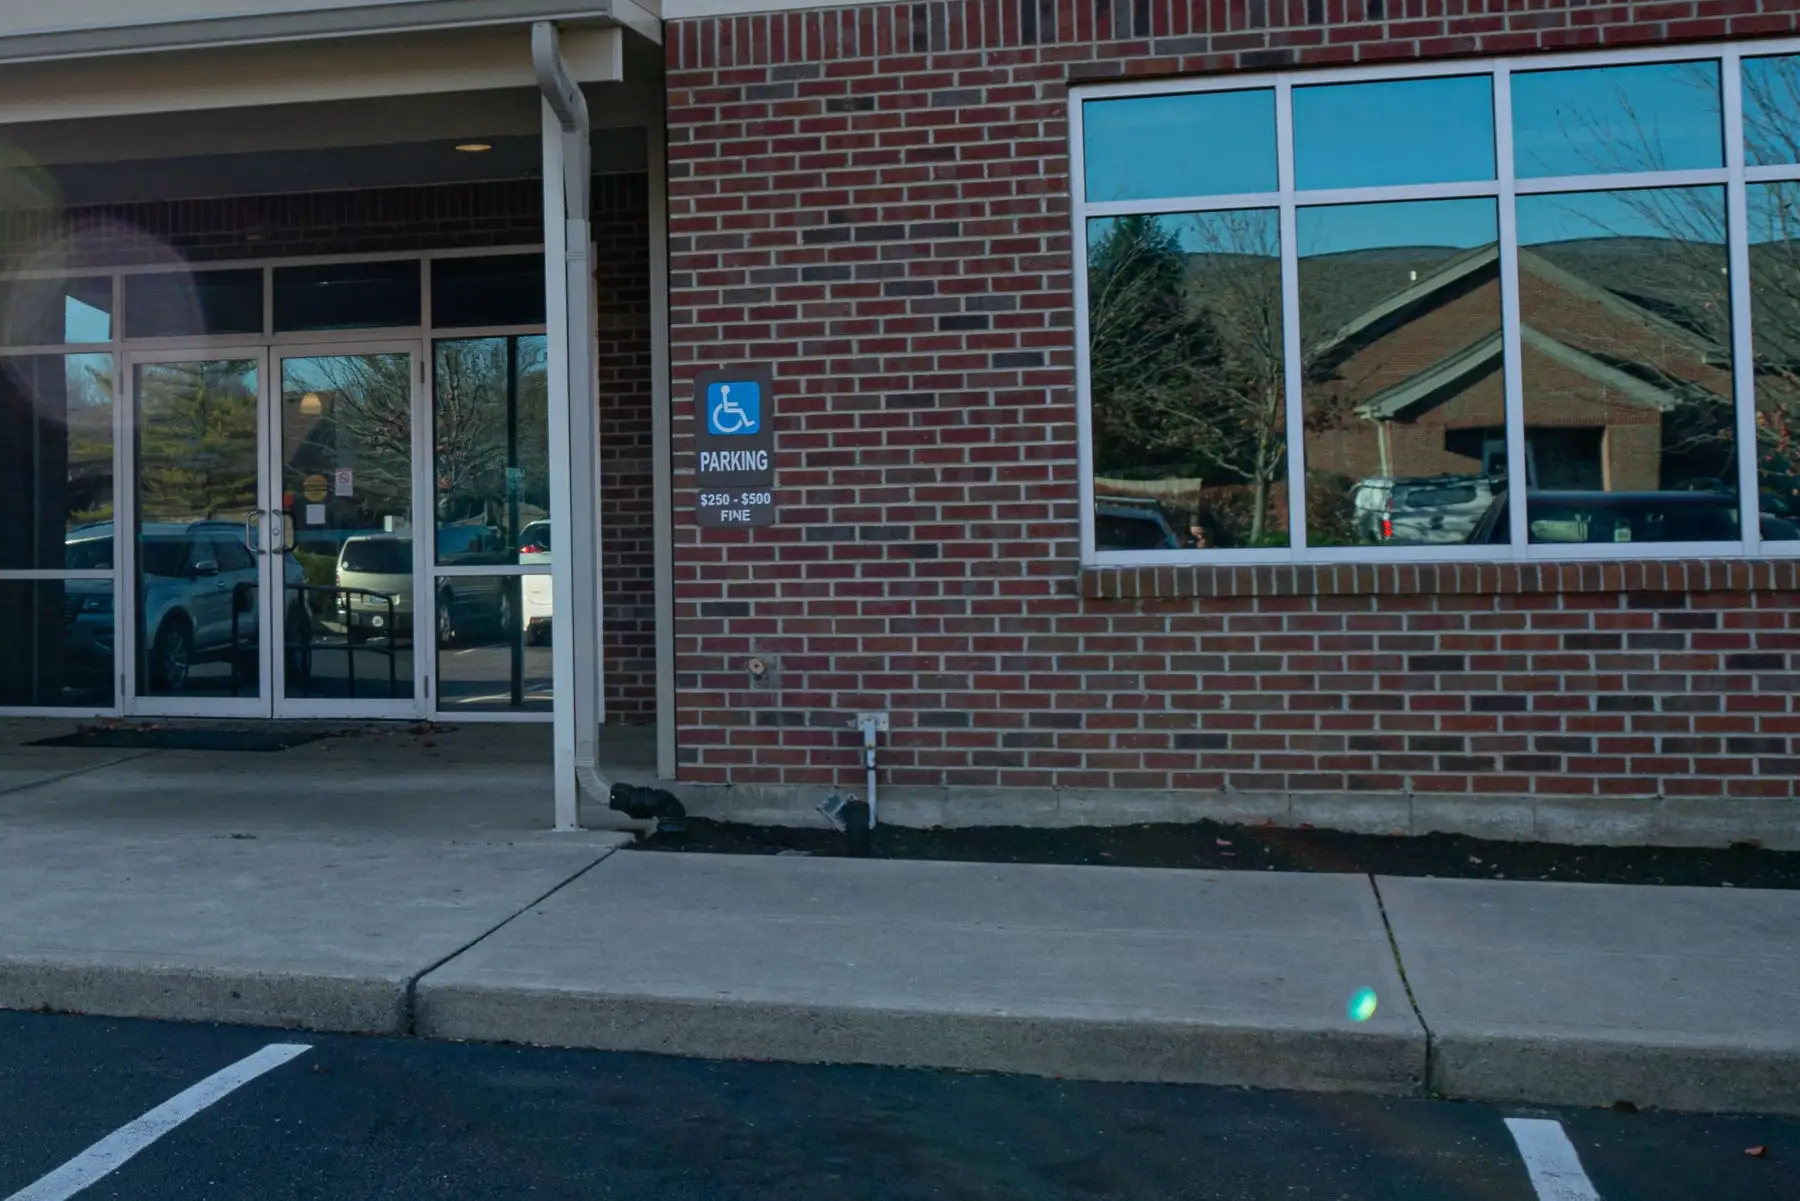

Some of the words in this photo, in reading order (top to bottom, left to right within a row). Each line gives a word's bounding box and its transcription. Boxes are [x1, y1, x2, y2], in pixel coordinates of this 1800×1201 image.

[700, 450, 768, 472] PARKING
[700, 493, 730, 507] $250
[741, 492, 771, 505] $500
[721, 509, 751, 522] FINE
